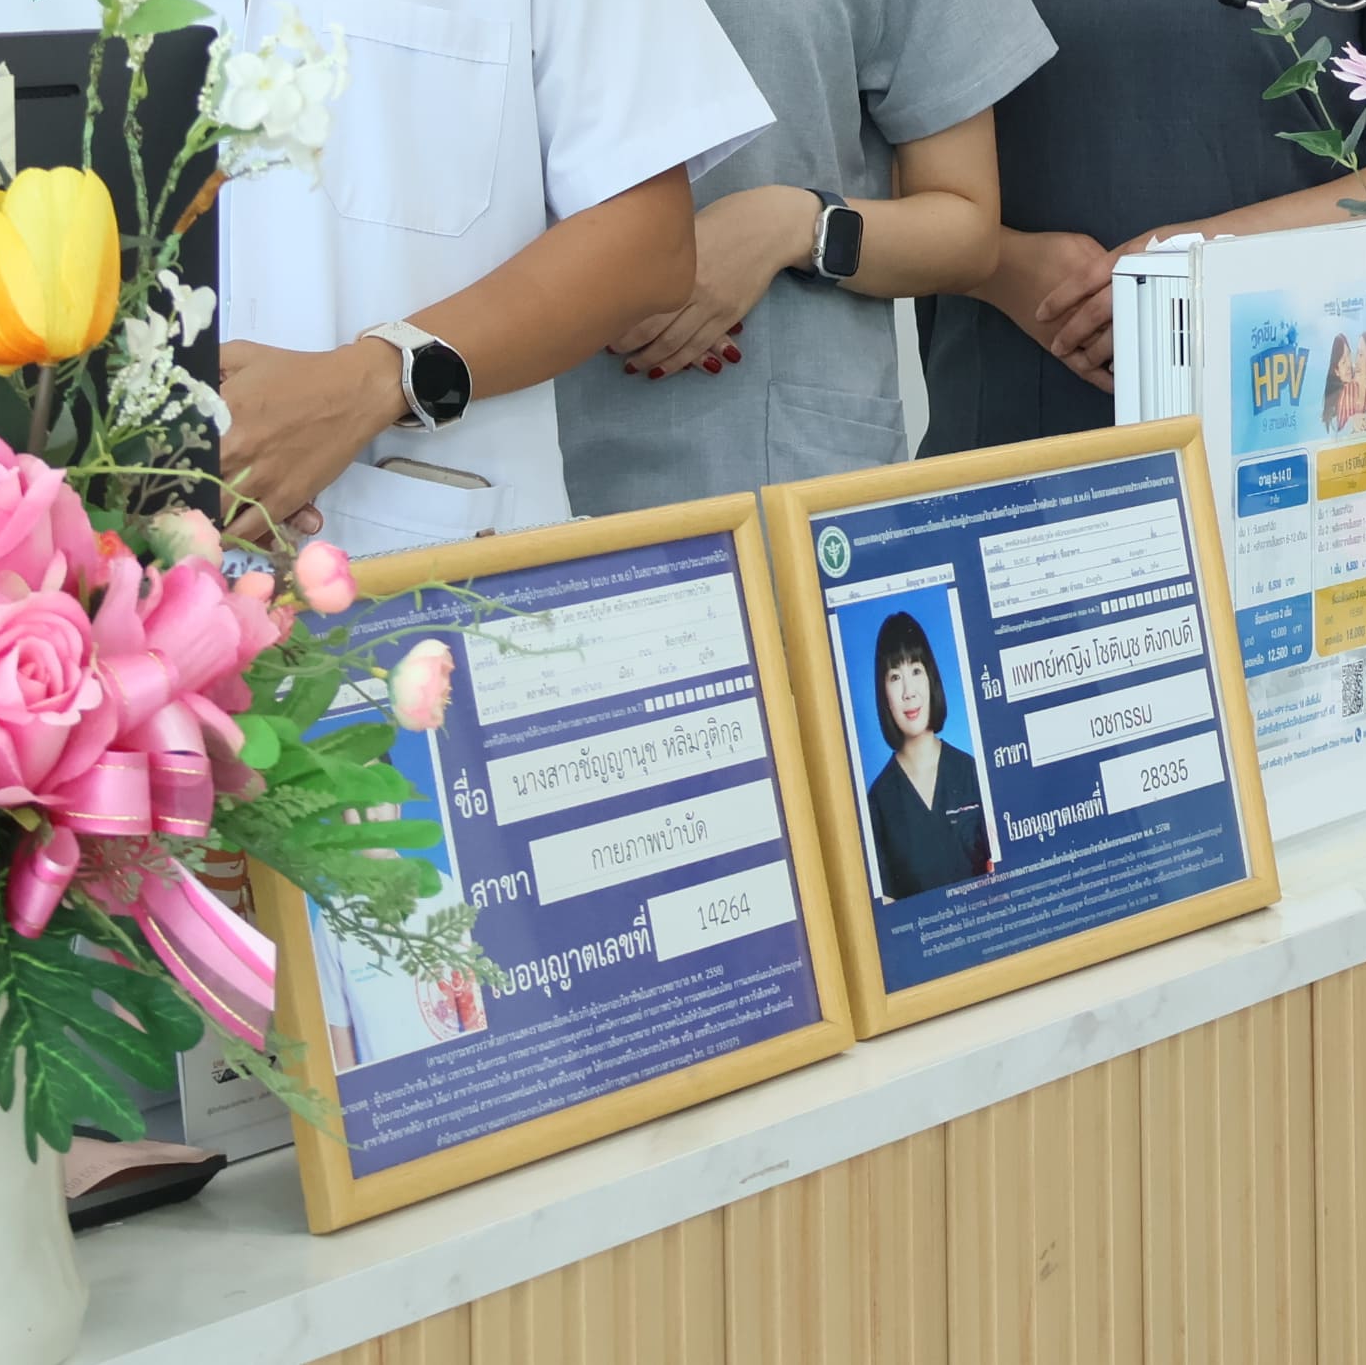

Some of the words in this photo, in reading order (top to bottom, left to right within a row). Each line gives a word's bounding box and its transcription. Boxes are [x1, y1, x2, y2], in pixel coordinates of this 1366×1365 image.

[1251, 320, 1277, 349] วัคซีน
[1253, 353, 1306, 408] HPV
[981, 664, 1002, 700] ชื่อ
[1012, 646, 1091, 686] แพทย์หญิง
[1093, 636, 1140, 667] โชตินุช
[1268, 644, 1288, 663] 12,500
[994, 742, 1029, 768] สาขา
[1090, 702, 1154, 739] เวชกรรม
[454, 768, 489, 818] ชื่อ
[513, 741, 657, 796] นางสาวชัญญานุช
[1003, 780, 1105, 843] ใบอนุญาตเลขที่
[1140, 758, 1190, 794] 28335
[471, 868, 531, 911] สาขา
[590, 813, 710, 872] กายภาพบำบัด
[490, 904, 652, 1000] ใบอนุญาตเลขที่
[697, 892, 752, 932] 14264
